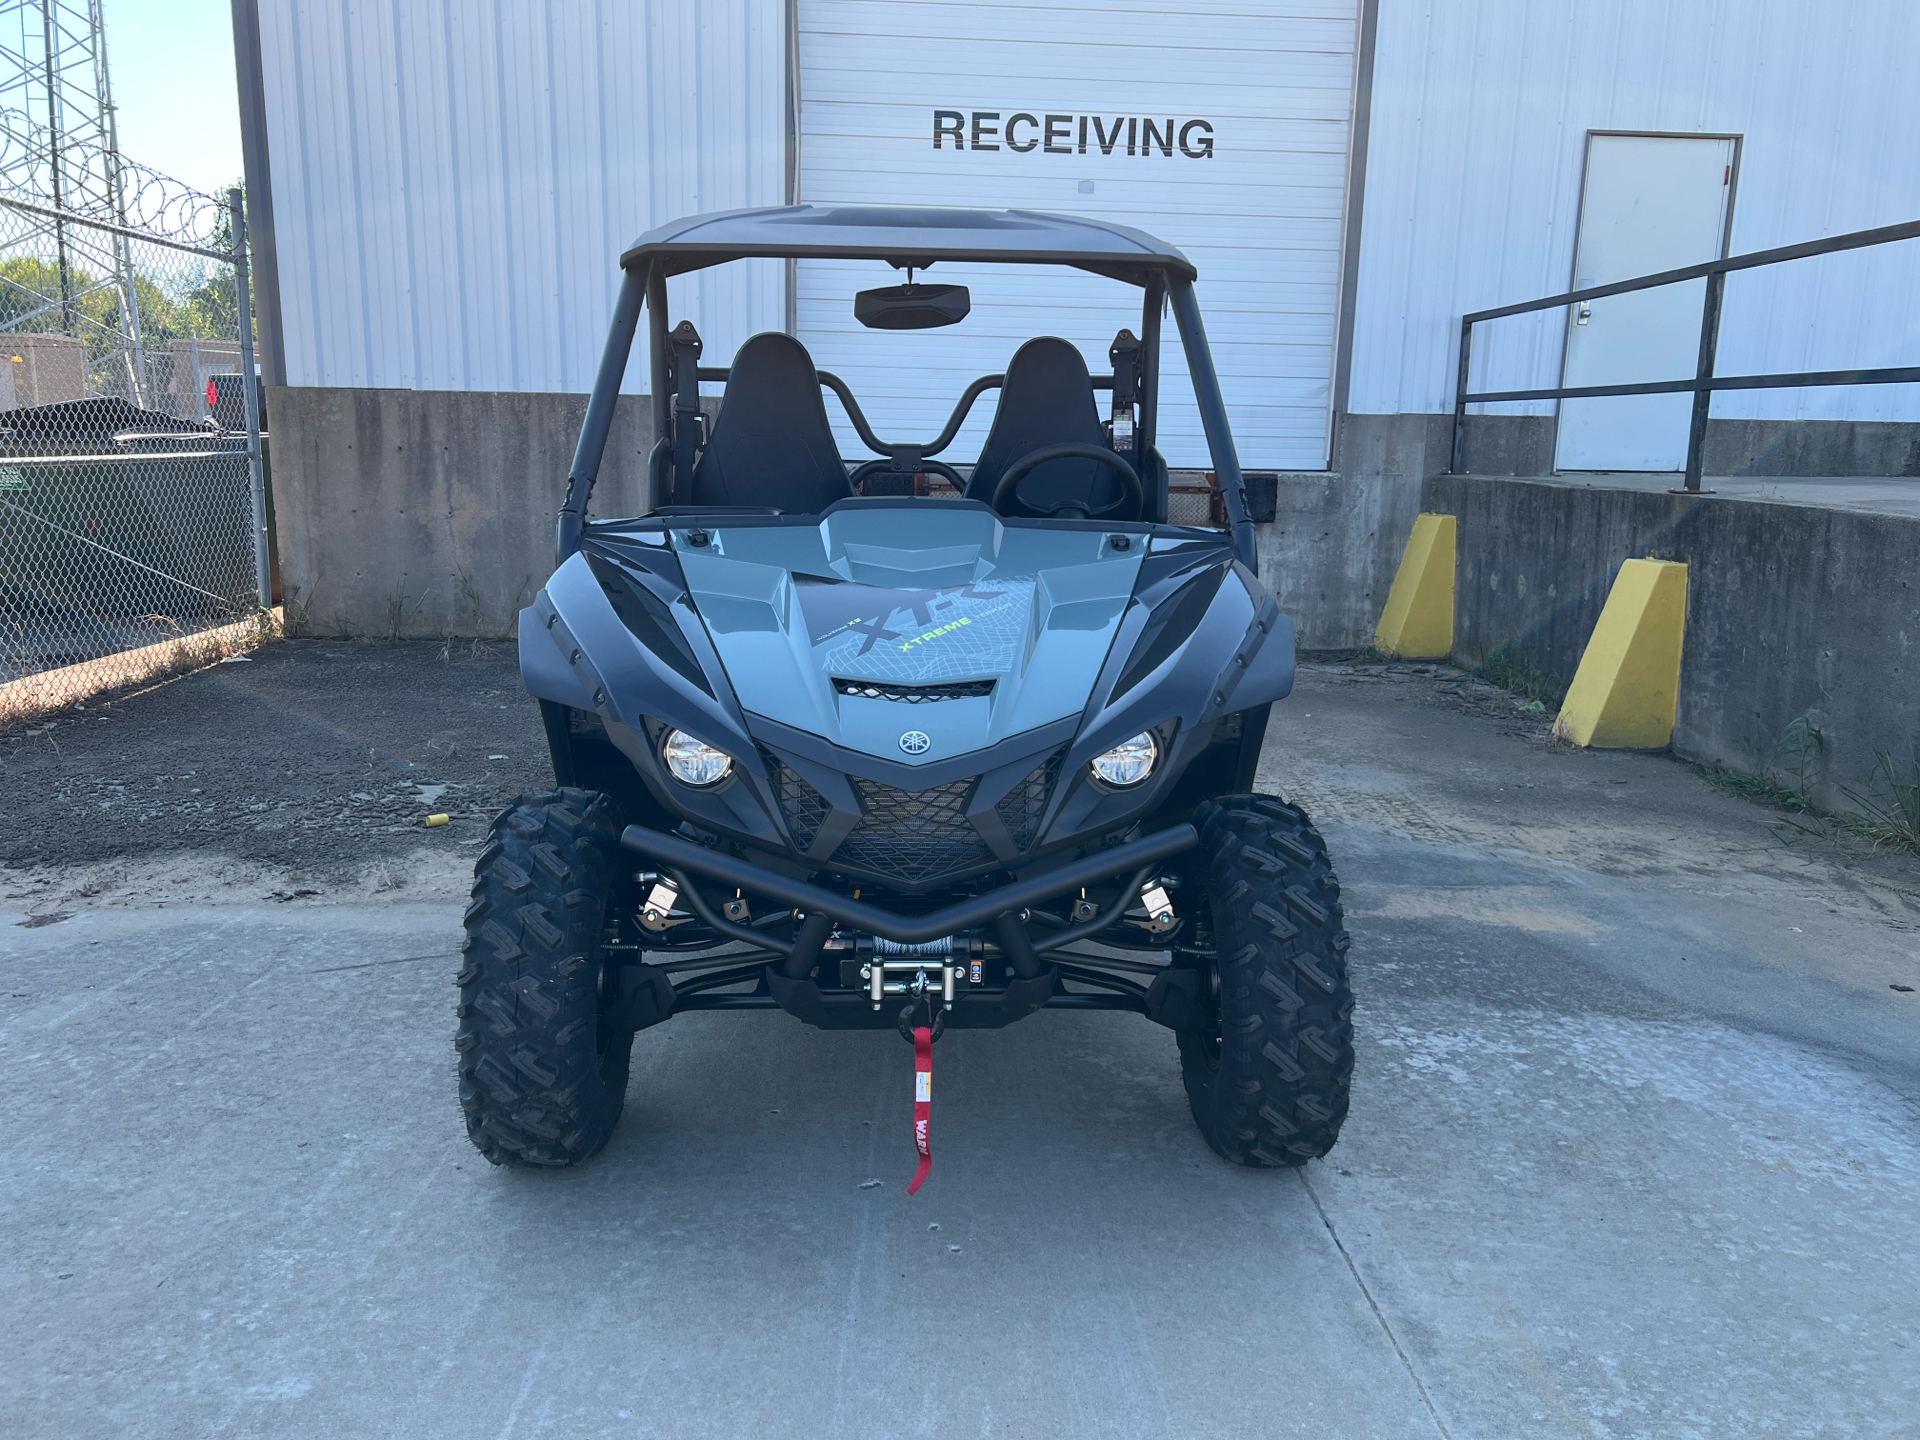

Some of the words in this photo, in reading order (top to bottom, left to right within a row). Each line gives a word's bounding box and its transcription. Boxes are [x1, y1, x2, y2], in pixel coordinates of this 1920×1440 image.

[932, 109, 1214, 159] RECEIVING
[898, 616, 972, 652] XTREME
[974, 602, 1013, 618] TERRAIN
[915, 1119, 929, 1156] WARN
